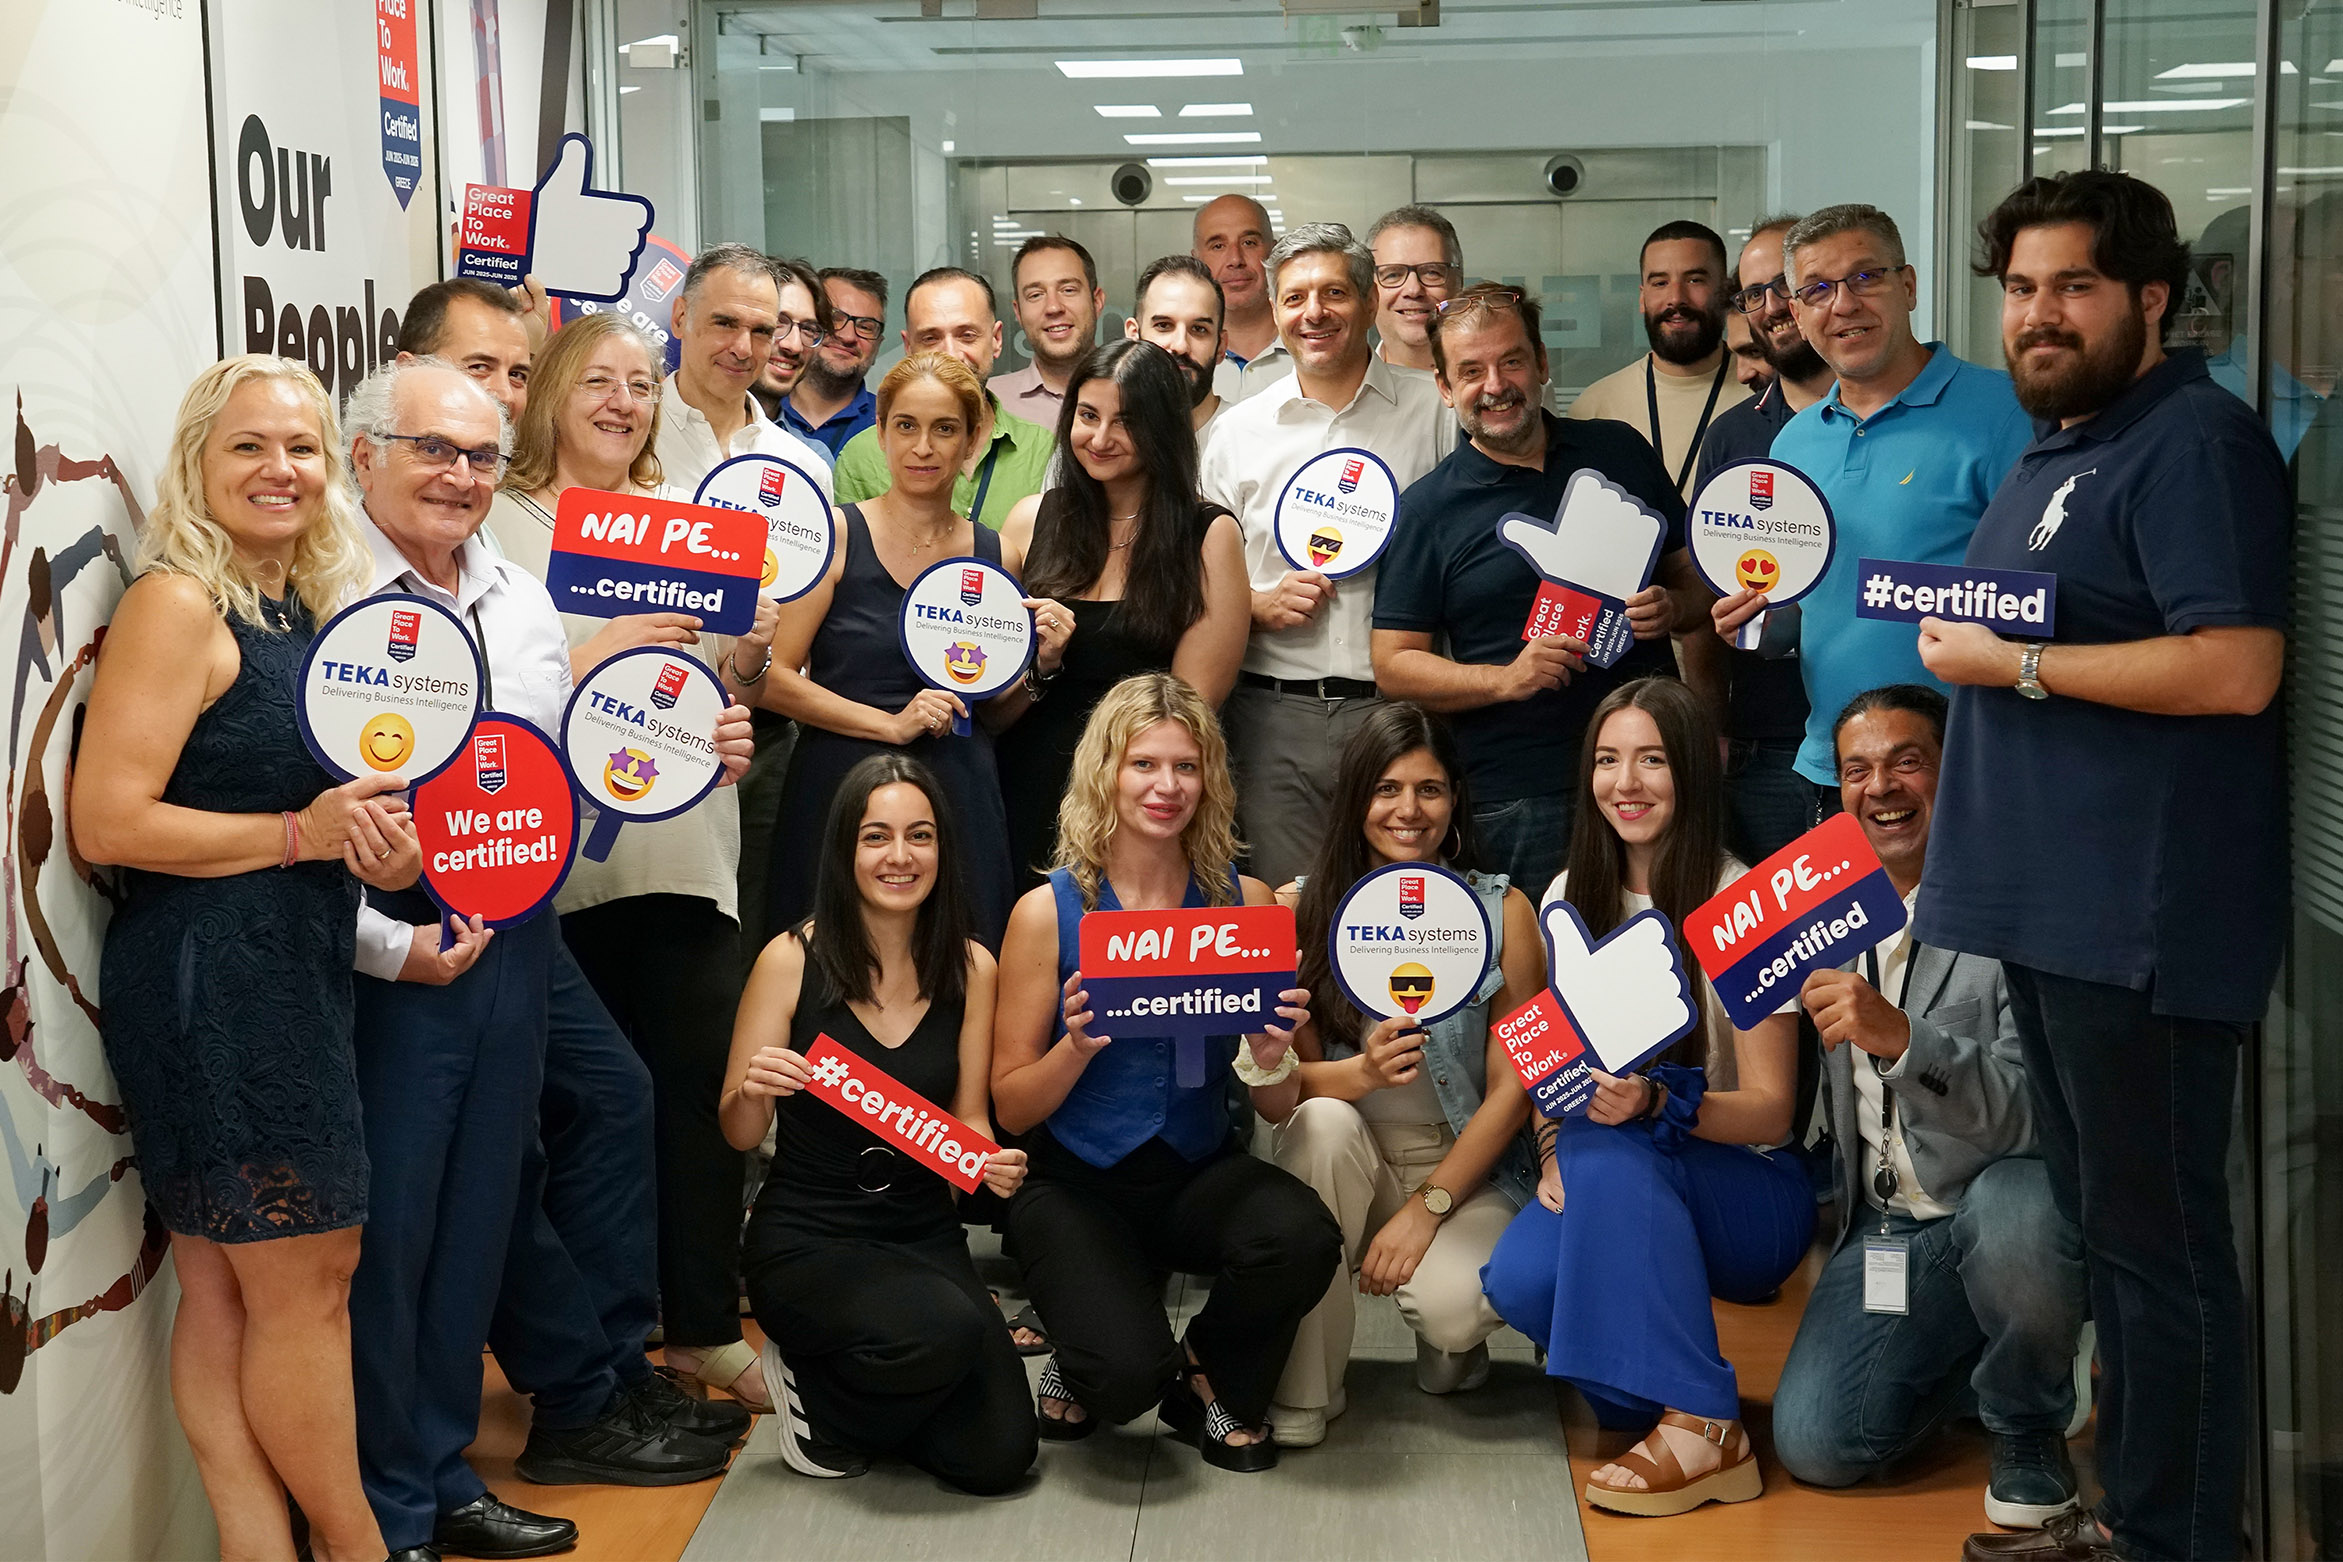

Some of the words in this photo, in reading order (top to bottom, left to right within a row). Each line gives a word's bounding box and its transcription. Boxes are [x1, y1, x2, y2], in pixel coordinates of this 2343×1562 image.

[379, 18, 391, 49] To
[384, 111, 417, 141] Certified
[238, 114, 331, 252] Our
[468, 187, 514, 205] Great
[466, 216, 484, 230] To
[468, 202, 512, 219] Place
[464, 253, 518, 270] Certified
[243, 275, 401, 403] People
[632, 311, 669, 345] are
[580, 512, 651, 545] NAI
[660, 518, 740, 561] PE...
[1703, 529, 1742, 541] Delivering
[1743, 534, 1776, 543] Business
[1777, 537, 1822, 548] Intelligence
[570, 578, 724, 613] ...certified
[1863, 574, 2046, 623] #certified
[393, 619, 413, 628] Place
[394, 612, 415, 621] Great
[1527, 597, 1552, 639] Great
[390, 643, 415, 651] Certified
[915, 621, 952, 635] Delivering
[953, 626, 983, 638] Business
[984, 631, 1024, 644] Intelligence
[1589, 609, 1614, 658] Certified
[1616, 630, 1629, 653] GREECE
[1602, 651, 1610, 663] JUN
[322, 685, 372, 702] Delivering
[374, 692, 414, 706] Business
[415, 698, 468, 712] Intelligence
[478, 739, 497, 747] Great
[584, 711, 626, 736] Delivering
[627, 728, 662, 749] Business
[663, 743, 711, 768] Intelligence
[480, 771, 503, 779] Certified
[445, 809, 491, 837] We
[496, 807, 543, 831] are
[433, 835, 557, 873] certified!
[1712, 890, 1764, 951] NAI
[1771, 855, 1850, 911] PE...
[1107, 926, 1174, 962] NAI
[1189, 923, 1271, 962] PE...
[1350, 945, 1392, 956] Delivering
[1394, 946, 1429, 954] Business
[1431, 945, 1479, 956] Intelligence
[1745, 901, 1869, 1003] ...certified
[1106, 988, 1261, 1017] ...certified
[1498, 1004, 1542, 1038] Great
[1505, 1020, 1549, 1054] Place
[1512, 1051, 1533, 1067] To
[812, 1055, 990, 1179] #certified
[1545, 1101, 1557, 1112] JUN
[1563, 1093, 1588, 1112] GREECE
